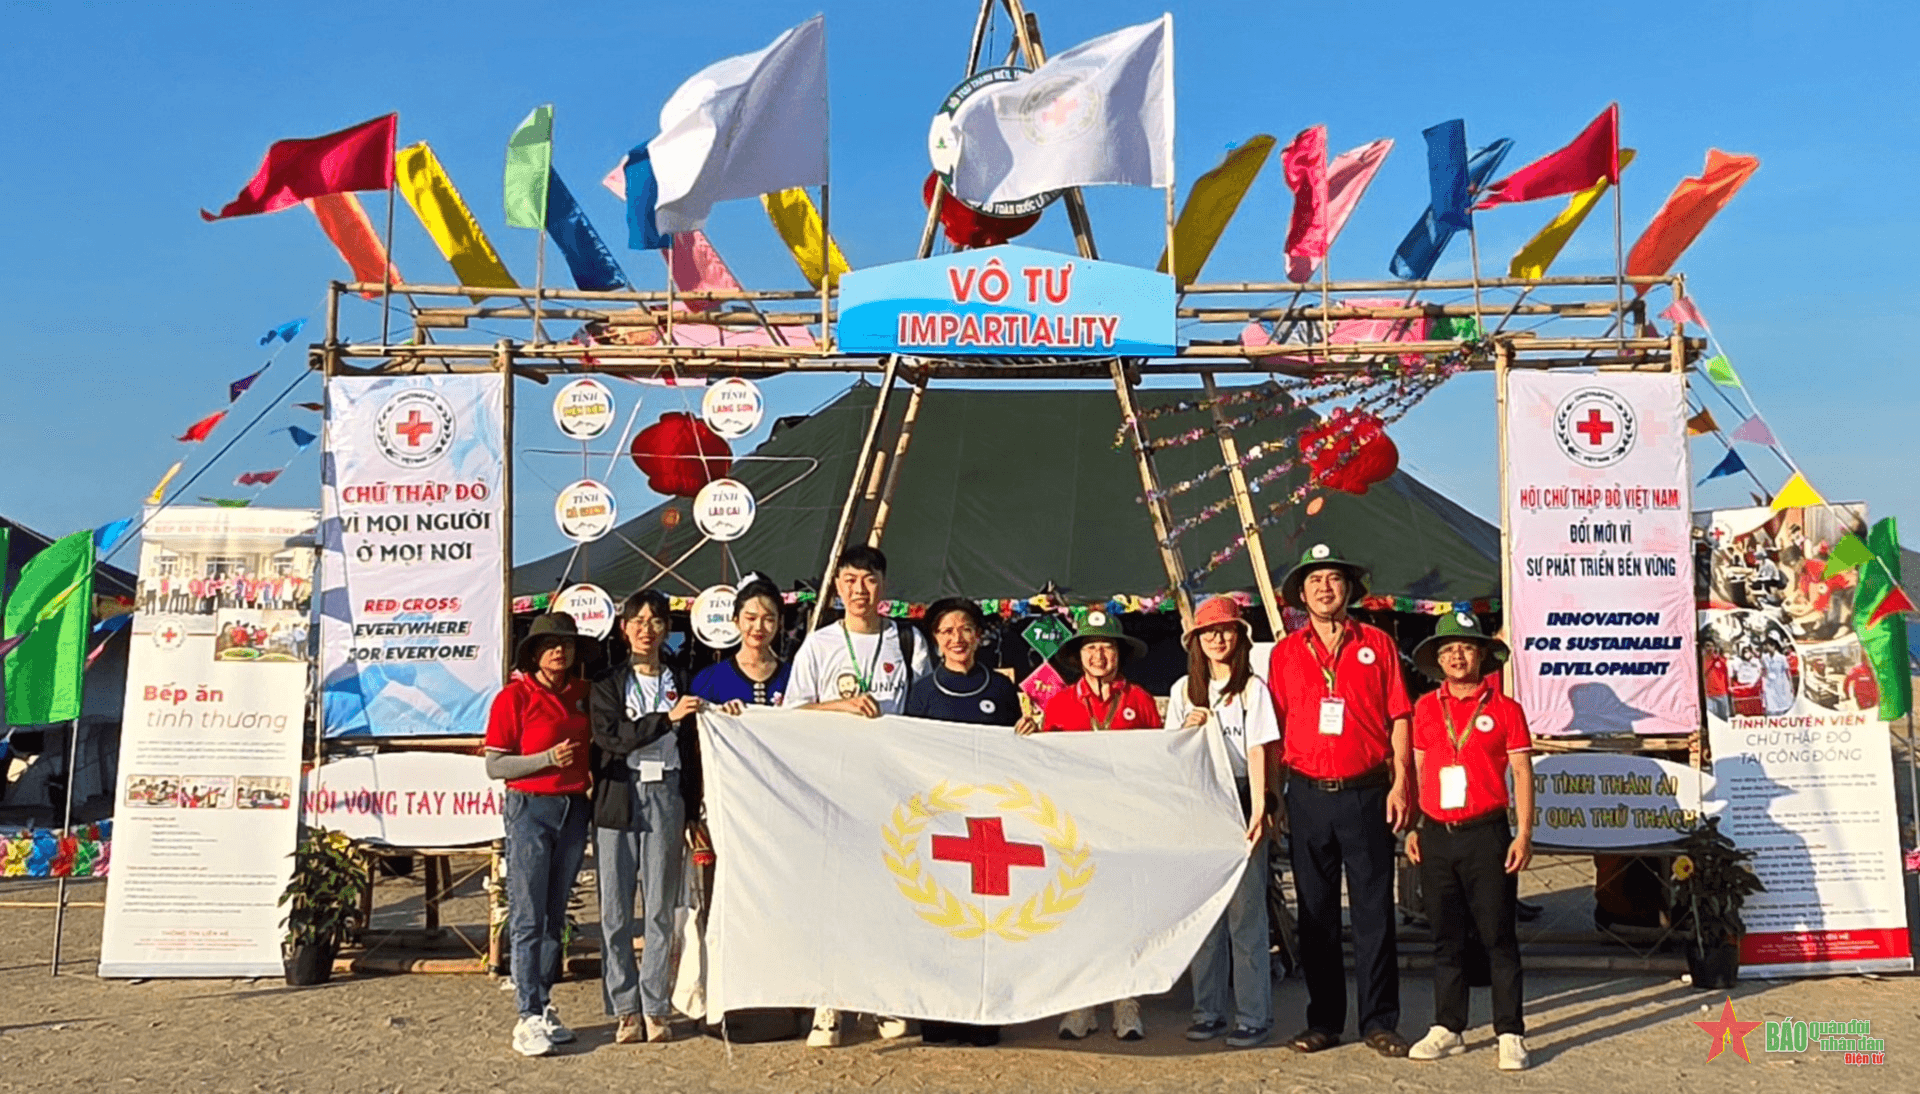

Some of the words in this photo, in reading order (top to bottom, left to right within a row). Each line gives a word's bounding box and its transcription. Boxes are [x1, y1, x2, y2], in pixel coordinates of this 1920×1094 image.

[949, 259, 1010, 303] VÔ
[1023, 263, 1073, 303] TƯ
[899, 315, 1118, 346] IMPARTIALITY
[342, 481, 388, 503] CHỮ
[394, 480, 451, 505] THẬP
[456, 477, 490, 502] ĐỎ
[1520, 485, 1541, 514] HỘI
[1544, 485, 1569, 508] CHỮ
[1571, 485, 1602, 514] THẬP
[1605, 482, 1622, 508] ĐỎ
[1624, 485, 1649, 514] VIỆT
[1652, 488, 1681, 509] NAM
[367, 514, 409, 535] MỌI
[417, 508, 491, 531] NGƯỜI
[1570, 516, 1590, 543] ĐỔI
[1593, 520, 1617, 543] MỚI
[1620, 520, 1632, 543] VÌ
[356, 539, 375, 562] Ở
[380, 545, 424, 565] MỌI
[431, 541, 474, 560] NƠI
[1526, 556, 1544, 581] SỰ
[1546, 552, 1576, 577] PHÁT
[1580, 550, 1614, 577] TRIỂN
[364, 599, 400, 613] RED
[403, 597, 460, 612] CROSS
[355, 620, 471, 637] EVERYWHERE
[1547, 612, 1660, 626] INNOVATION
[386, 645, 479, 661] EVERYONE
[1524, 637, 1561, 651] FOR
[1566, 636, 1683, 651] SUSTAINABLE
[1539, 661, 1670, 676] DEVELOPMENT
[143, 682, 188, 706] Bếp
[195, 684, 224, 702] ăn
[147, 709, 193, 728] tình
[201, 709, 288, 733] thương
[1826, 728, 1852, 743] ĐỎ
[1551, 770, 1595, 795] TÌNH
[1600, 771, 1651, 795] THÂN
[344, 786, 398, 815] VÒNG
[405, 791, 446, 815] TAY
[1547, 806, 1586, 829] QUA
